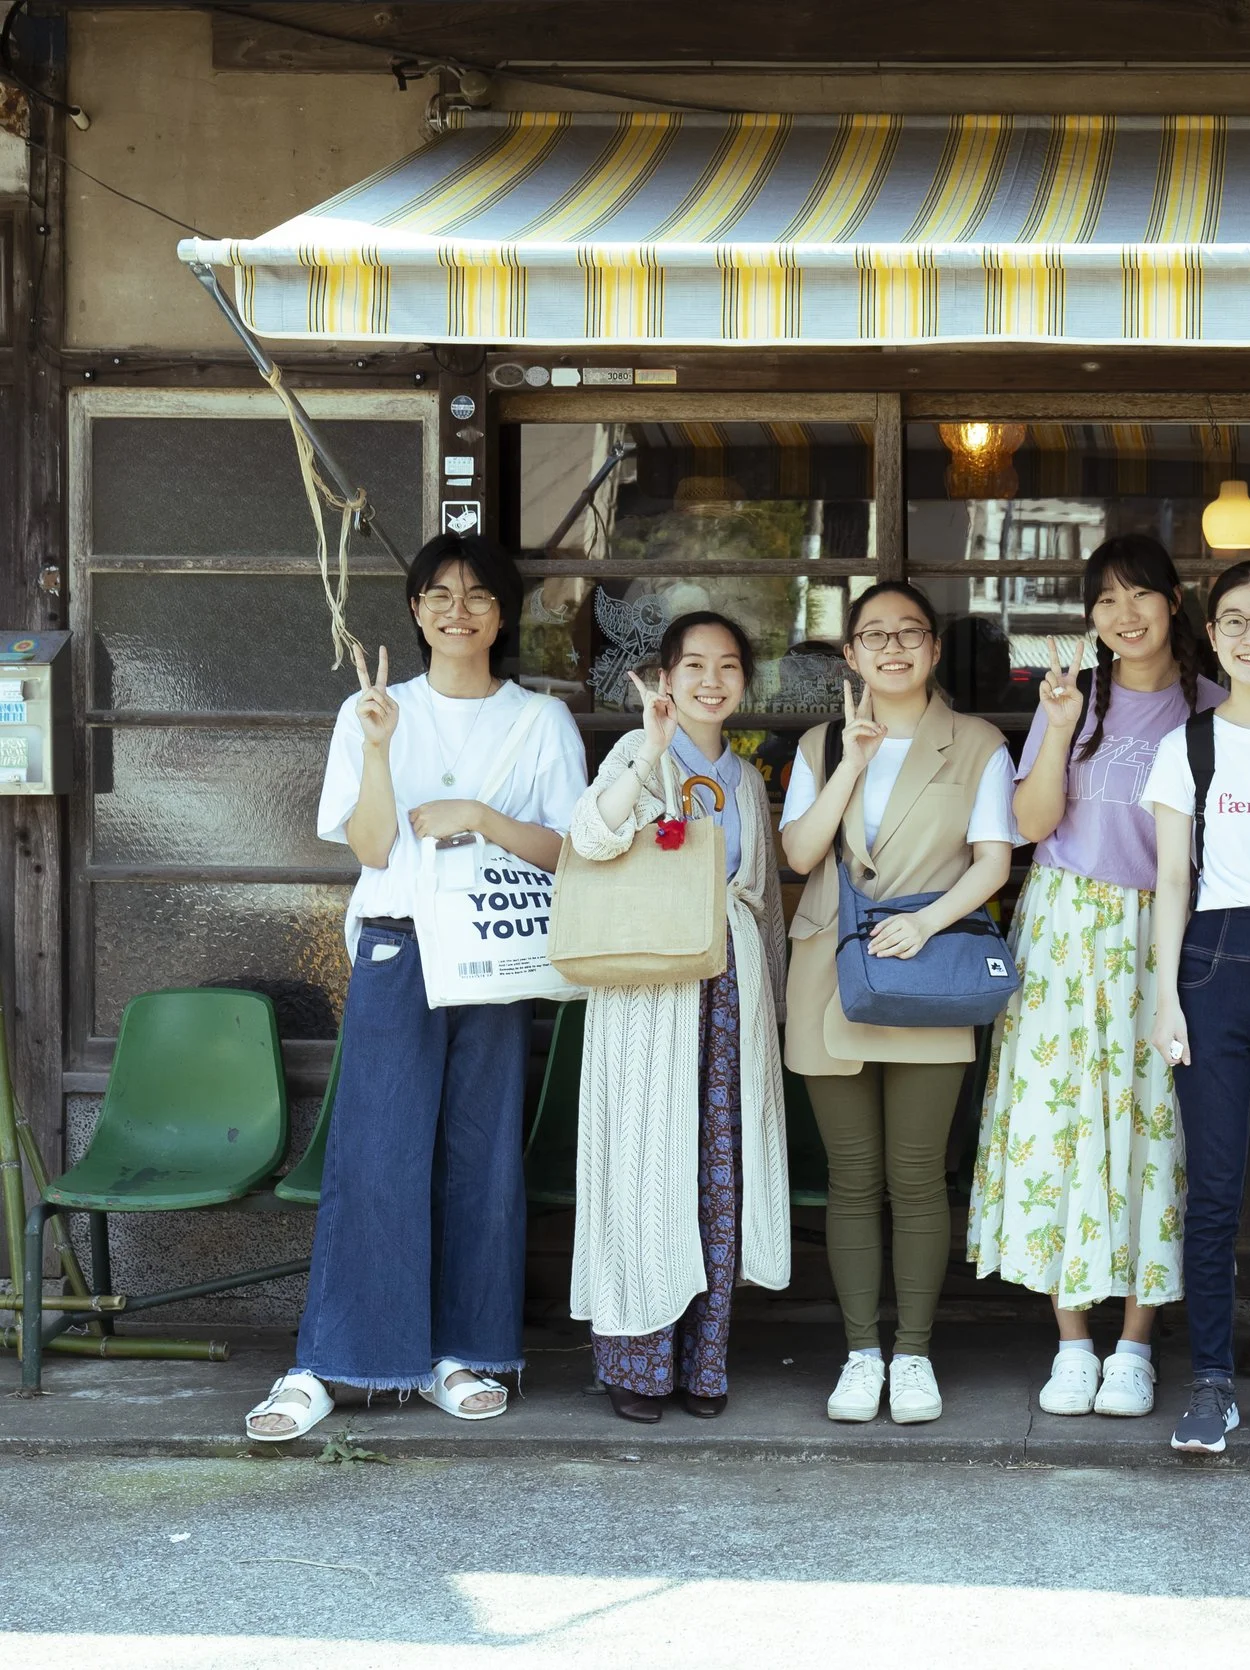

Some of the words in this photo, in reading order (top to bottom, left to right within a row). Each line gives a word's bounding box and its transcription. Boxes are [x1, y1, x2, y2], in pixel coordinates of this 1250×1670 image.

[607, 372, 629, 380] 3080
[772, 701, 845, 713] FARME
[480, 866, 553, 887] OUTH
[472, 916, 550, 940] YOUT
